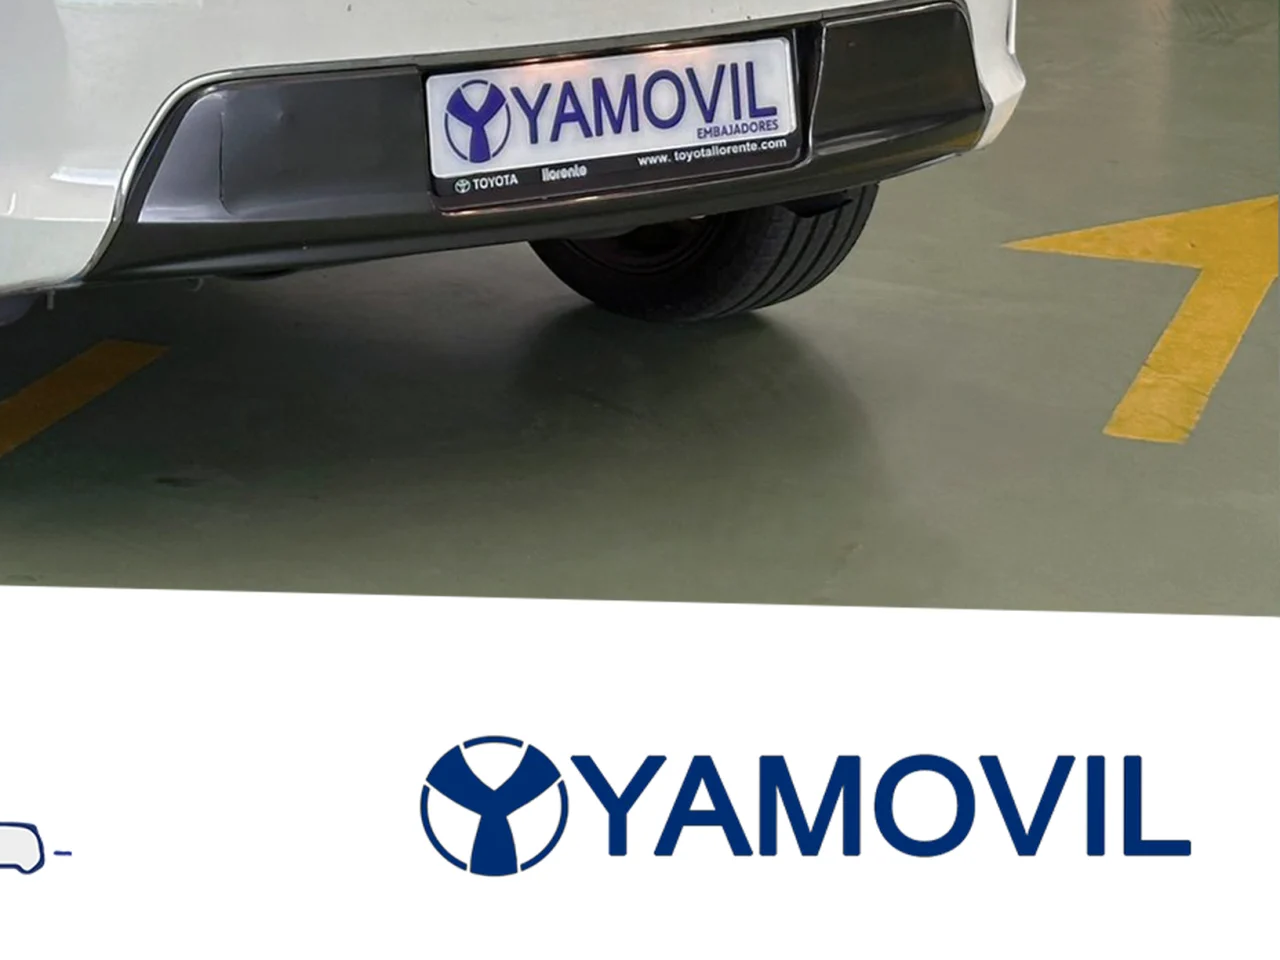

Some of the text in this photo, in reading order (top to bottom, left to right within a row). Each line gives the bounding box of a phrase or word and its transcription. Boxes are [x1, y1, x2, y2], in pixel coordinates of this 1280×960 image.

[510, 61, 778, 145] YAMOVIL
[696, 118, 780, 140] EMBAJADORES
[472, 173, 519, 191] TOYOTA
[541, 164, 588, 182] llorente
